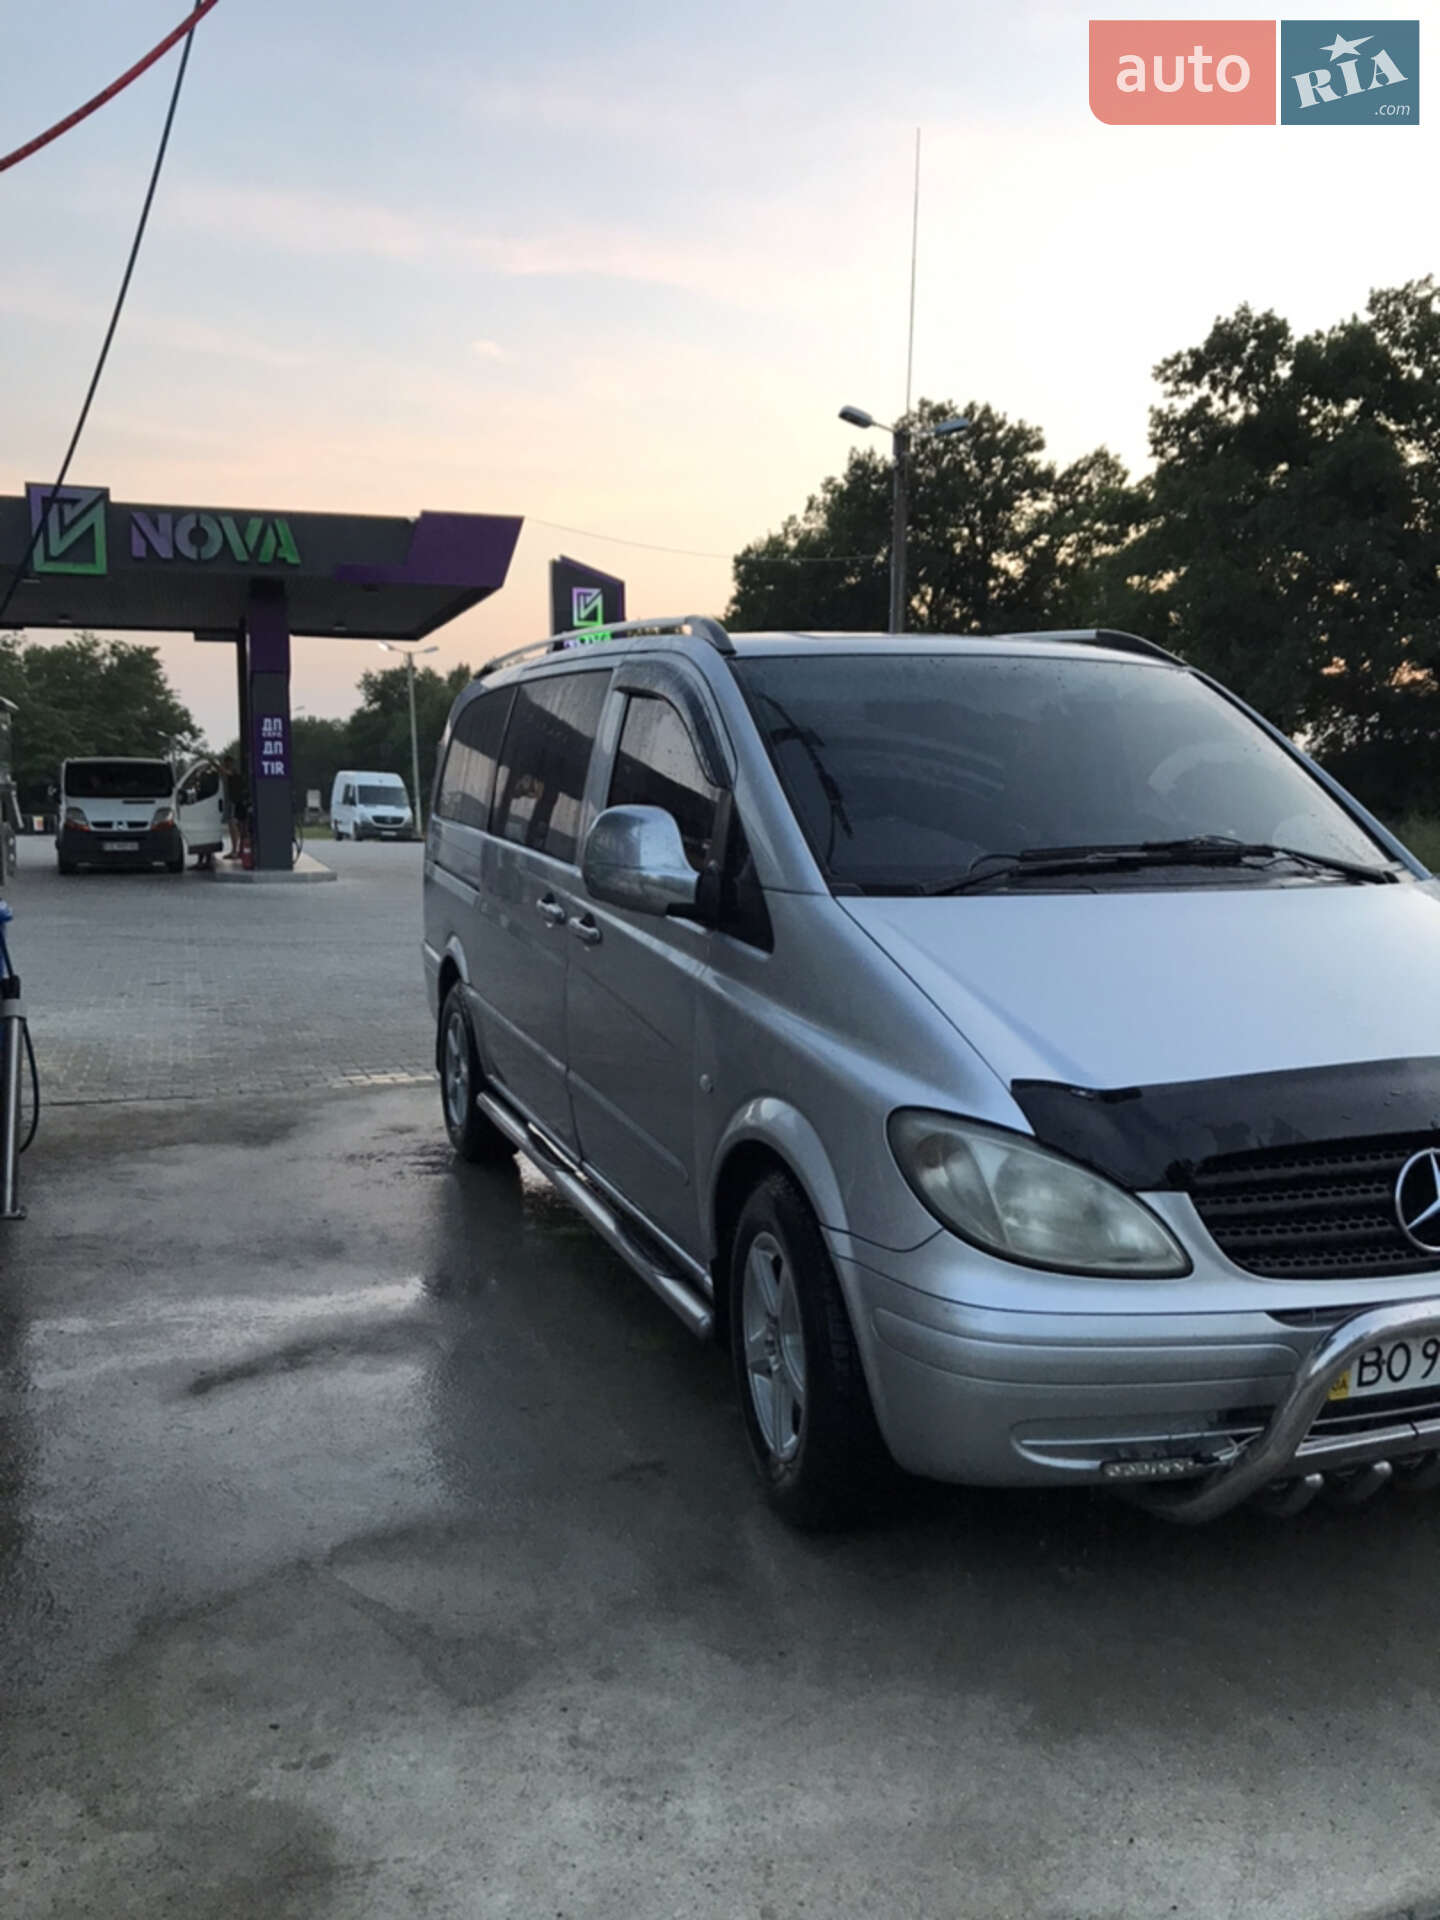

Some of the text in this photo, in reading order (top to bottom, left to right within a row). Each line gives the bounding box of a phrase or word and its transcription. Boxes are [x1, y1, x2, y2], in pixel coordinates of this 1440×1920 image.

[131, 511, 301, 566] NOVA
[262, 718, 283, 732] ДП
[263, 741, 284, 755] ДП
[262, 761, 285, 776] TIR
